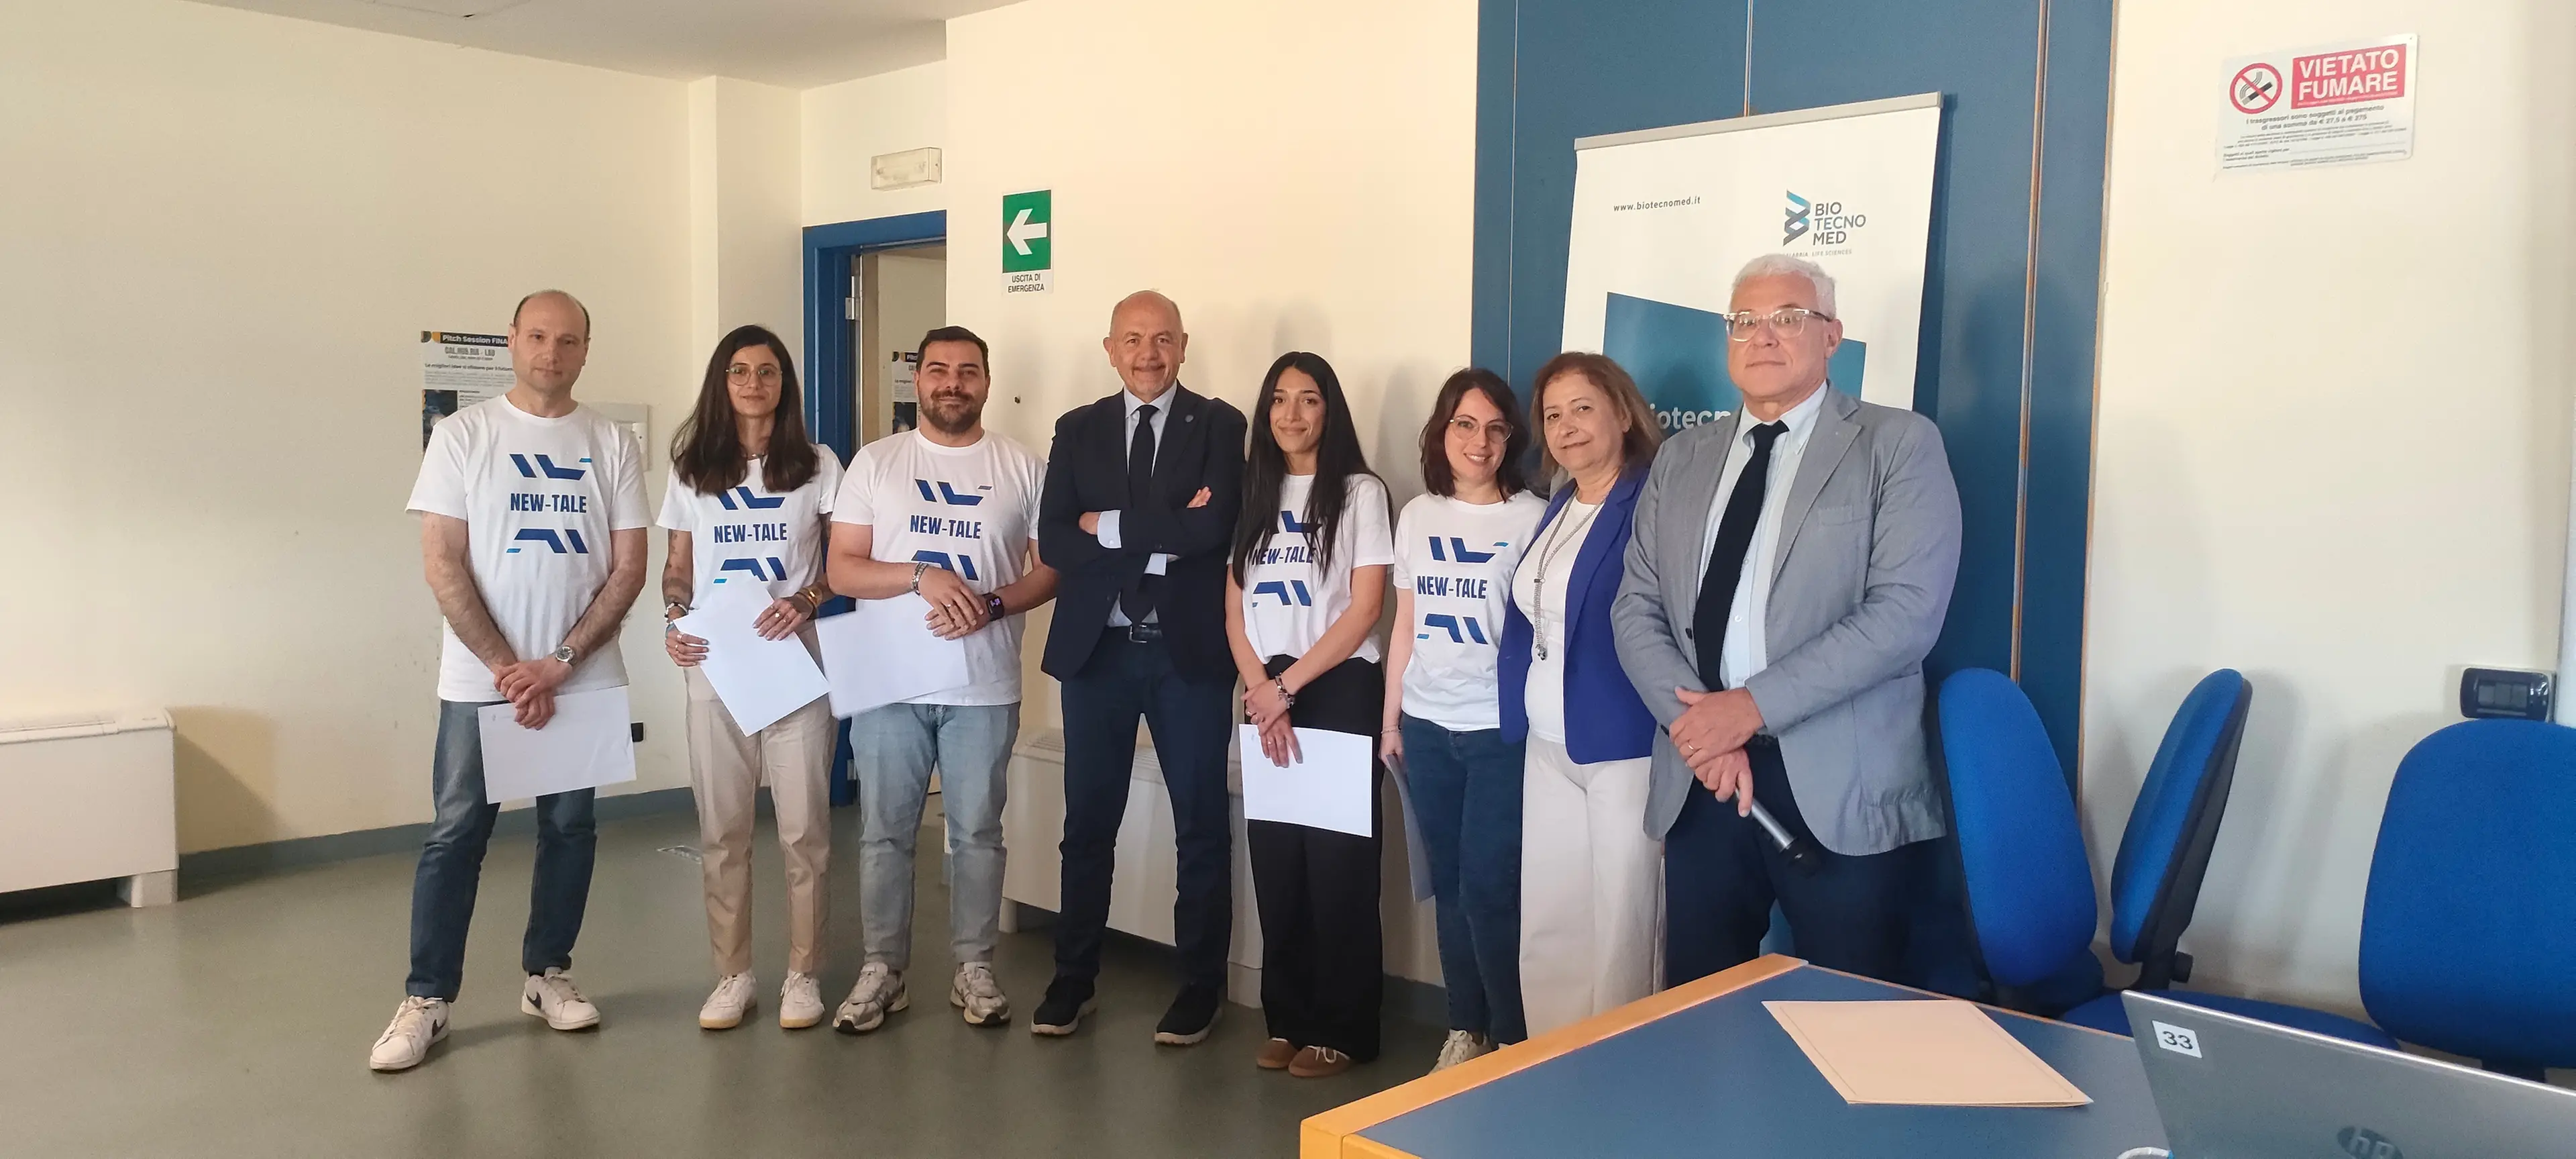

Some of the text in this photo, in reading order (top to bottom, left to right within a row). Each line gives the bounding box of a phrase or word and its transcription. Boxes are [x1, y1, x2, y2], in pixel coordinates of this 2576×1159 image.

[2300, 49, 2399, 79] VIETATO
[2299, 70, 2398, 101] FUMARE
[2250, 114, 2290, 124] trasgressori
[2309, 109, 2336, 117] soggetti
[2345, 105, 2385, 115] pagamento
[1613, 196, 1701, 211] www.biotecnomed.it
[1815, 201, 1841, 216] BIO
[1814, 214, 1866, 231] TECNO
[1813, 231, 1846, 246] MED
[1825, 248, 1852, 256] SCIENCES
[1012, 273, 1040, 283] USCITA DI
[1008, 283, 1044, 293] EMERGENZA
[442, 334, 508, 345] Pitch Session FINA
[511, 493, 587, 513] NEW-TALE
[714, 523, 788, 543] NEW-TALE
[910, 515, 981, 540] NEW-TALE
[1417, 576, 1488, 599] NEW-TALE
[2163, 1030, 2193, 1050] 33
